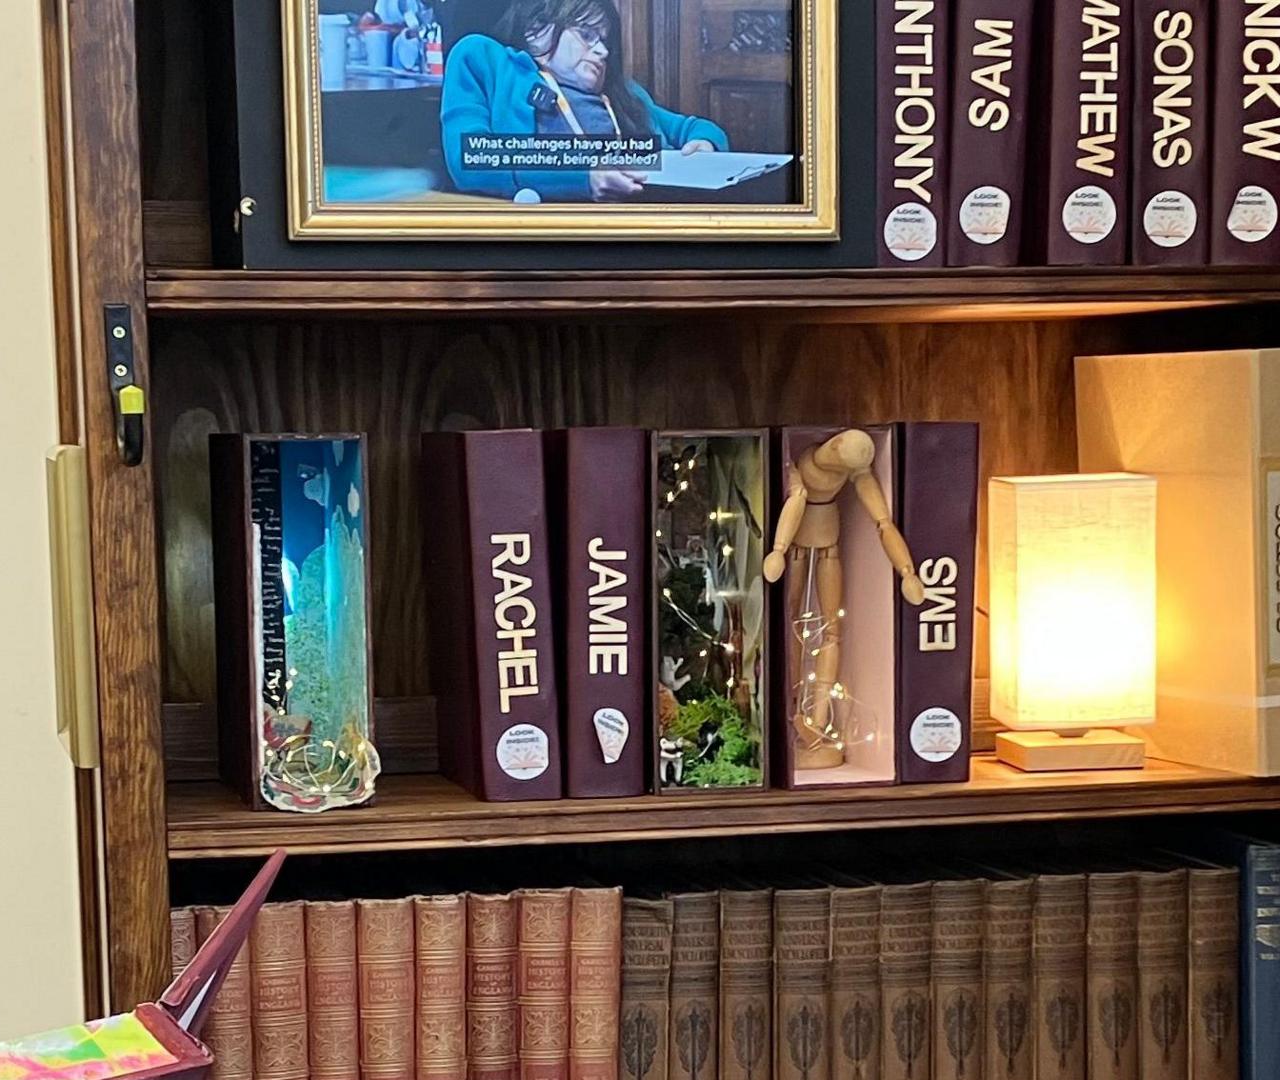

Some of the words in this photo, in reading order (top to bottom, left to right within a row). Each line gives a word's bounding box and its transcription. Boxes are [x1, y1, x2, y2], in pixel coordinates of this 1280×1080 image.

[894, 0, 936, 204] NTHONY
[968, 19, 1014, 131] SAM
[1152, 10, 1194, 168] SONAS
[464, 152, 500, 167] being
[502, 156, 510, 164] a
[512, 153, 561, 166] mother,
[563, 152, 599, 167] being
[600, 153, 658, 165] disabled?
[468, 137, 504, 149] What
[505, 137, 572, 151] challenges
[573, 137, 603, 149] have
[604, 140, 628, 152] you
[629, 137, 654, 150] had
[490, 533, 539, 714] RACHEL
[588, 537, 628, 675] JAMIE
[917, 556, 958, 651] EMS
